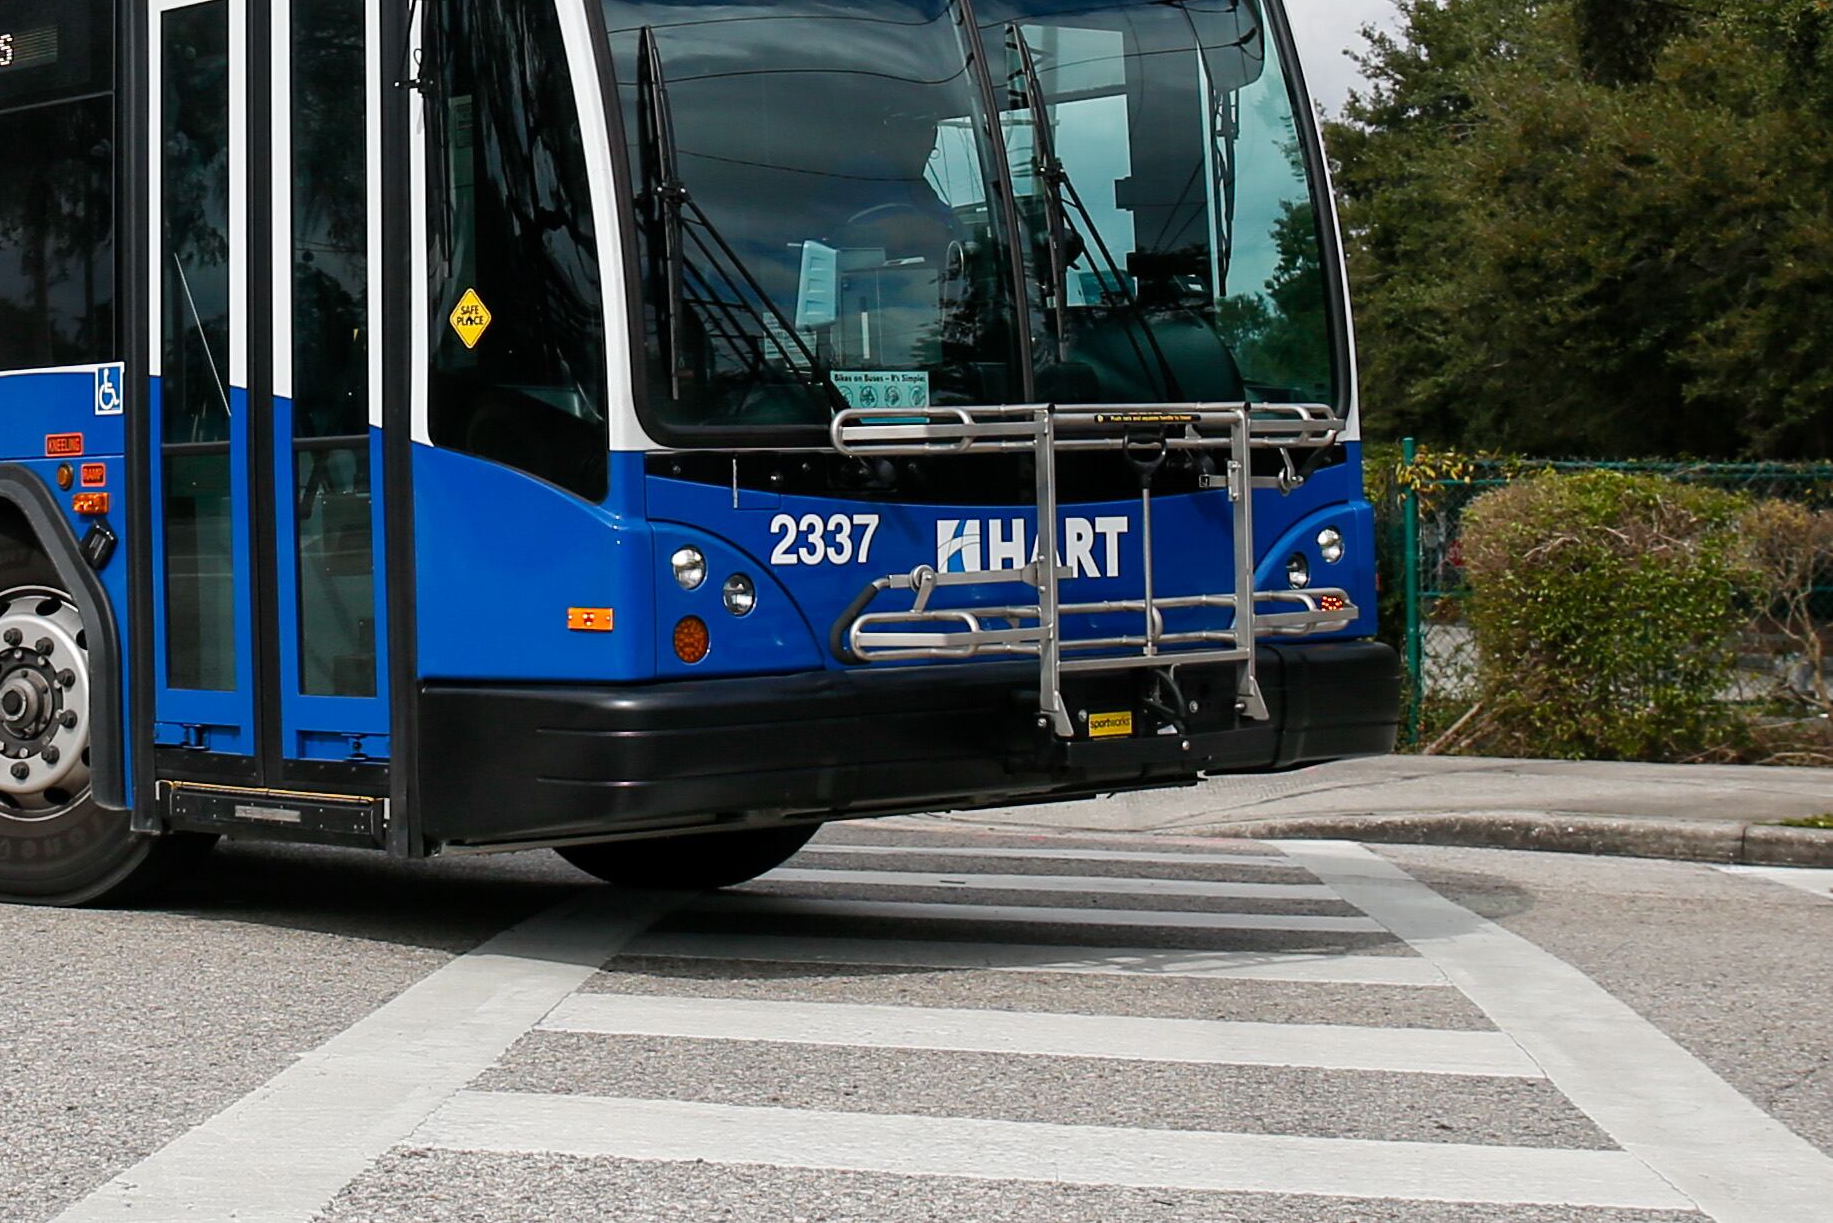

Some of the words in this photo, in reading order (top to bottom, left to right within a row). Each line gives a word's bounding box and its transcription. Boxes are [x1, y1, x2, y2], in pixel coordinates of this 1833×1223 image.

[461, 305, 479, 315] SAFE
[457, 316, 484, 326] PLACE
[83, 468, 103, 481] RAMP
[769, 514, 879, 565] 2337
